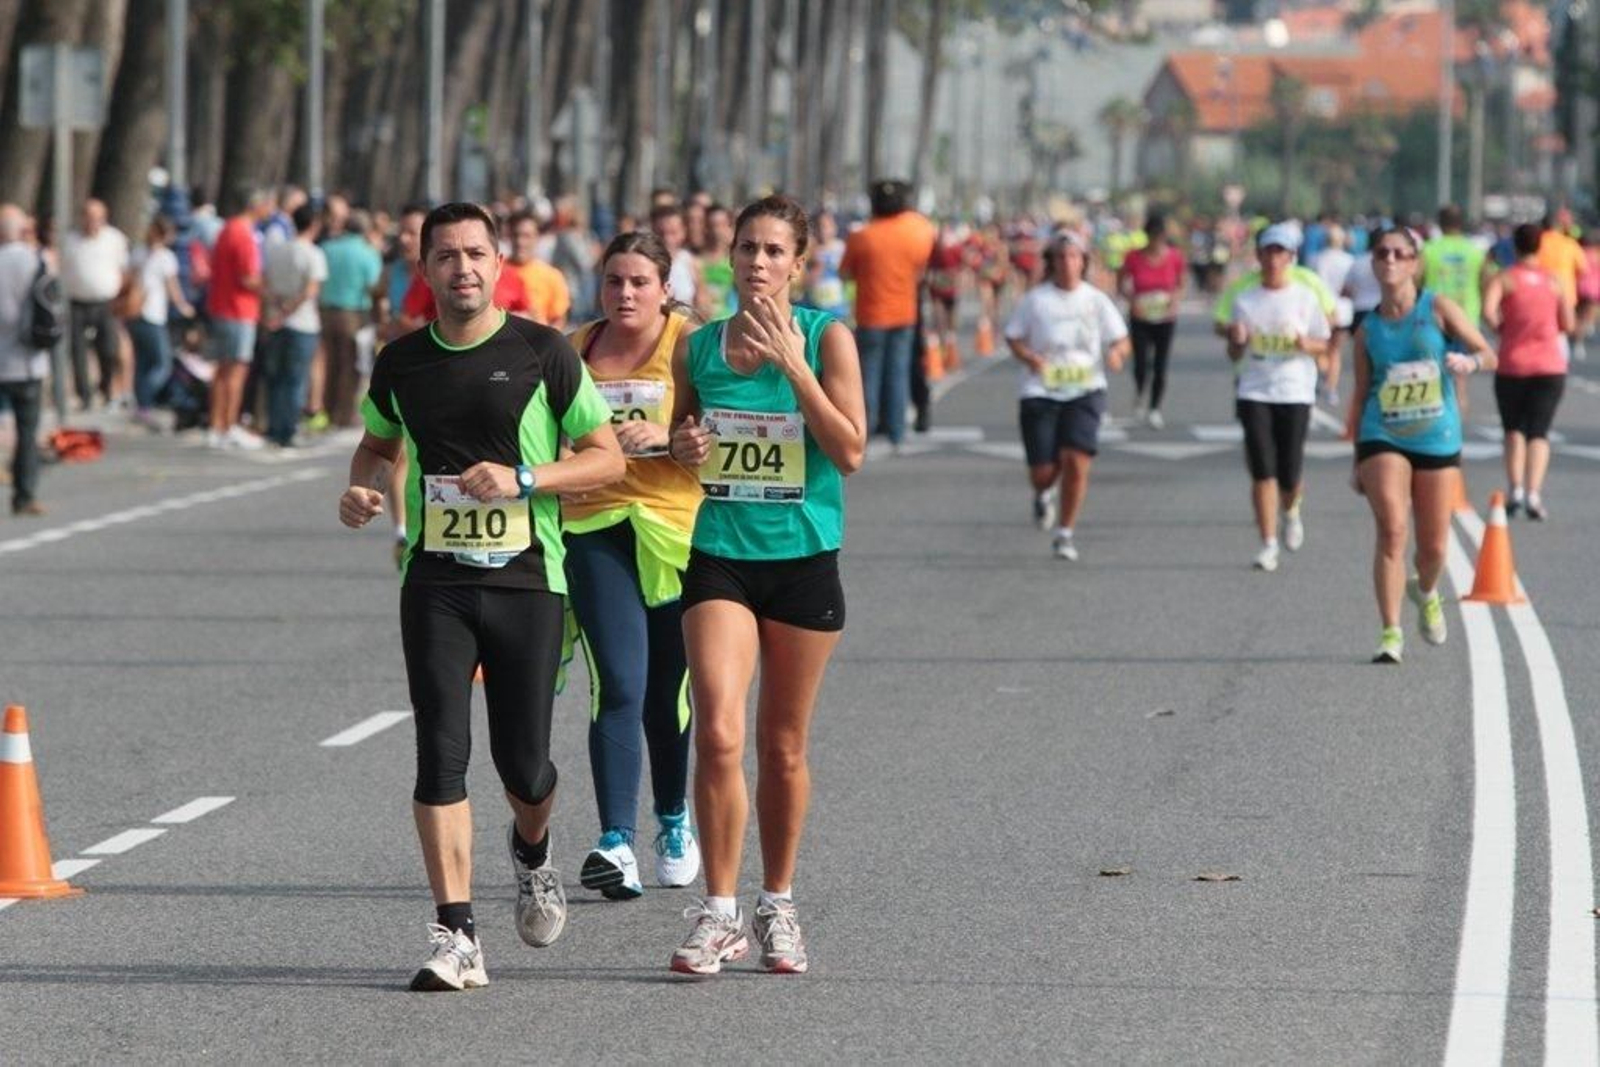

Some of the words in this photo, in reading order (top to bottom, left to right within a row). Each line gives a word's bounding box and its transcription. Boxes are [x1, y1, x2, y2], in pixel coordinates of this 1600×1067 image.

[1388, 381, 1429, 403] 727
[718, 441, 785, 474] 704
[441, 508, 507, 540] 210
